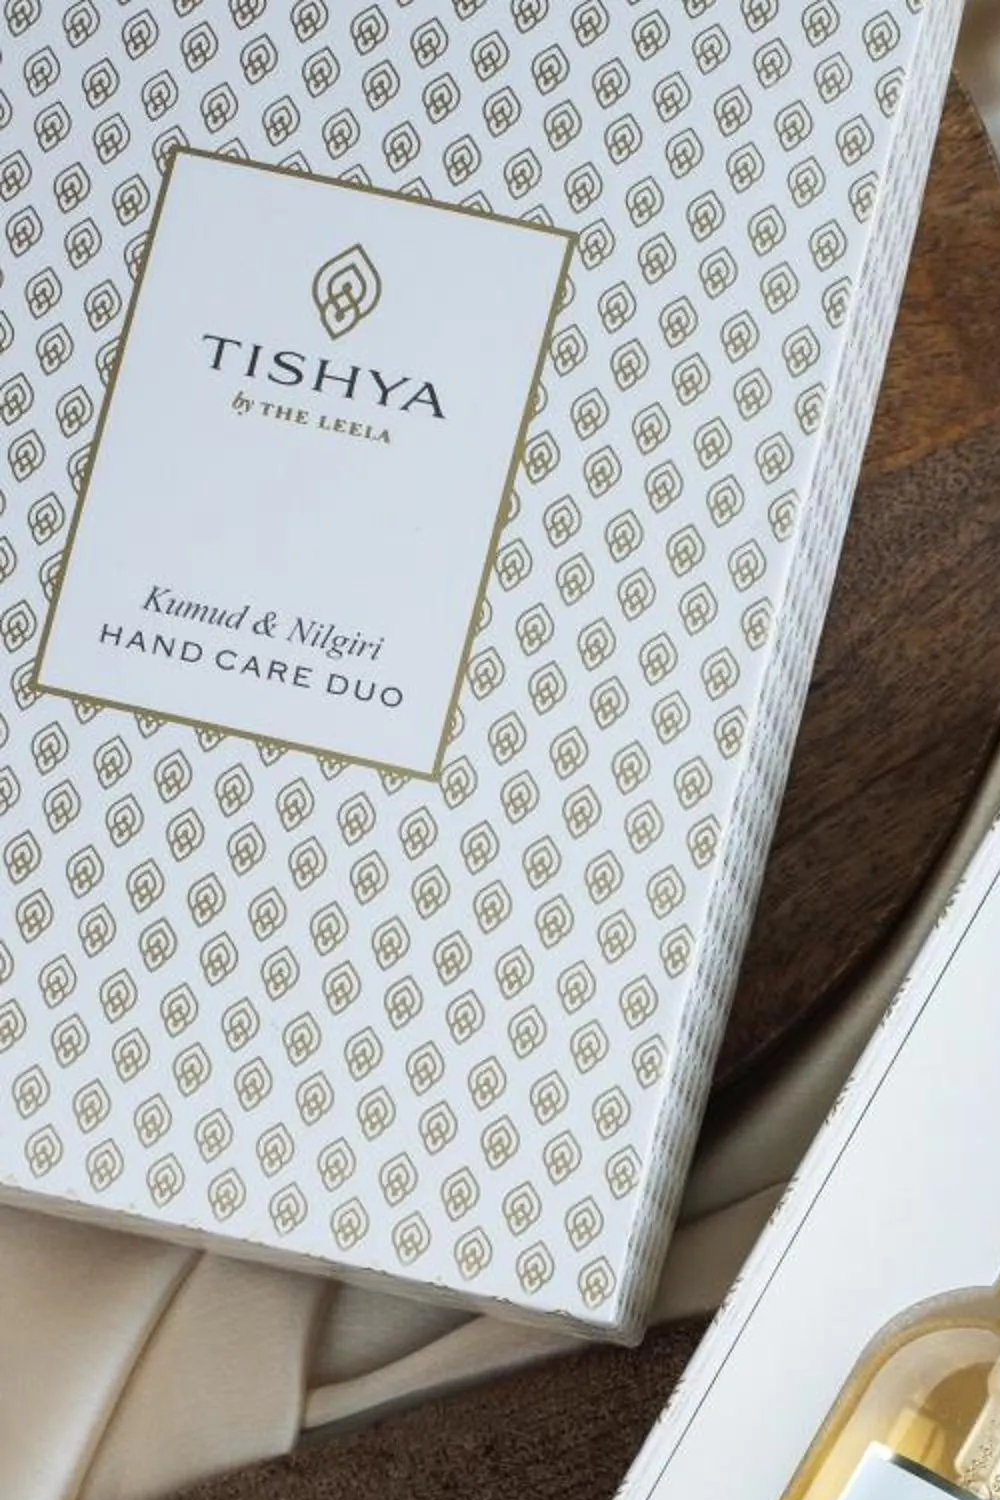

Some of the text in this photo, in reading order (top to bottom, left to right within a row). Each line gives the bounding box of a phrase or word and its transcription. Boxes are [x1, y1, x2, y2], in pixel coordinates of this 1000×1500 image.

[203, 334, 446, 419] TISHYA
[232, 391, 391, 444] by THE LEELA
[142, 585, 385, 660] Kumud & Nilgiri
[99, 623, 403, 707] HAND CARE DUO
